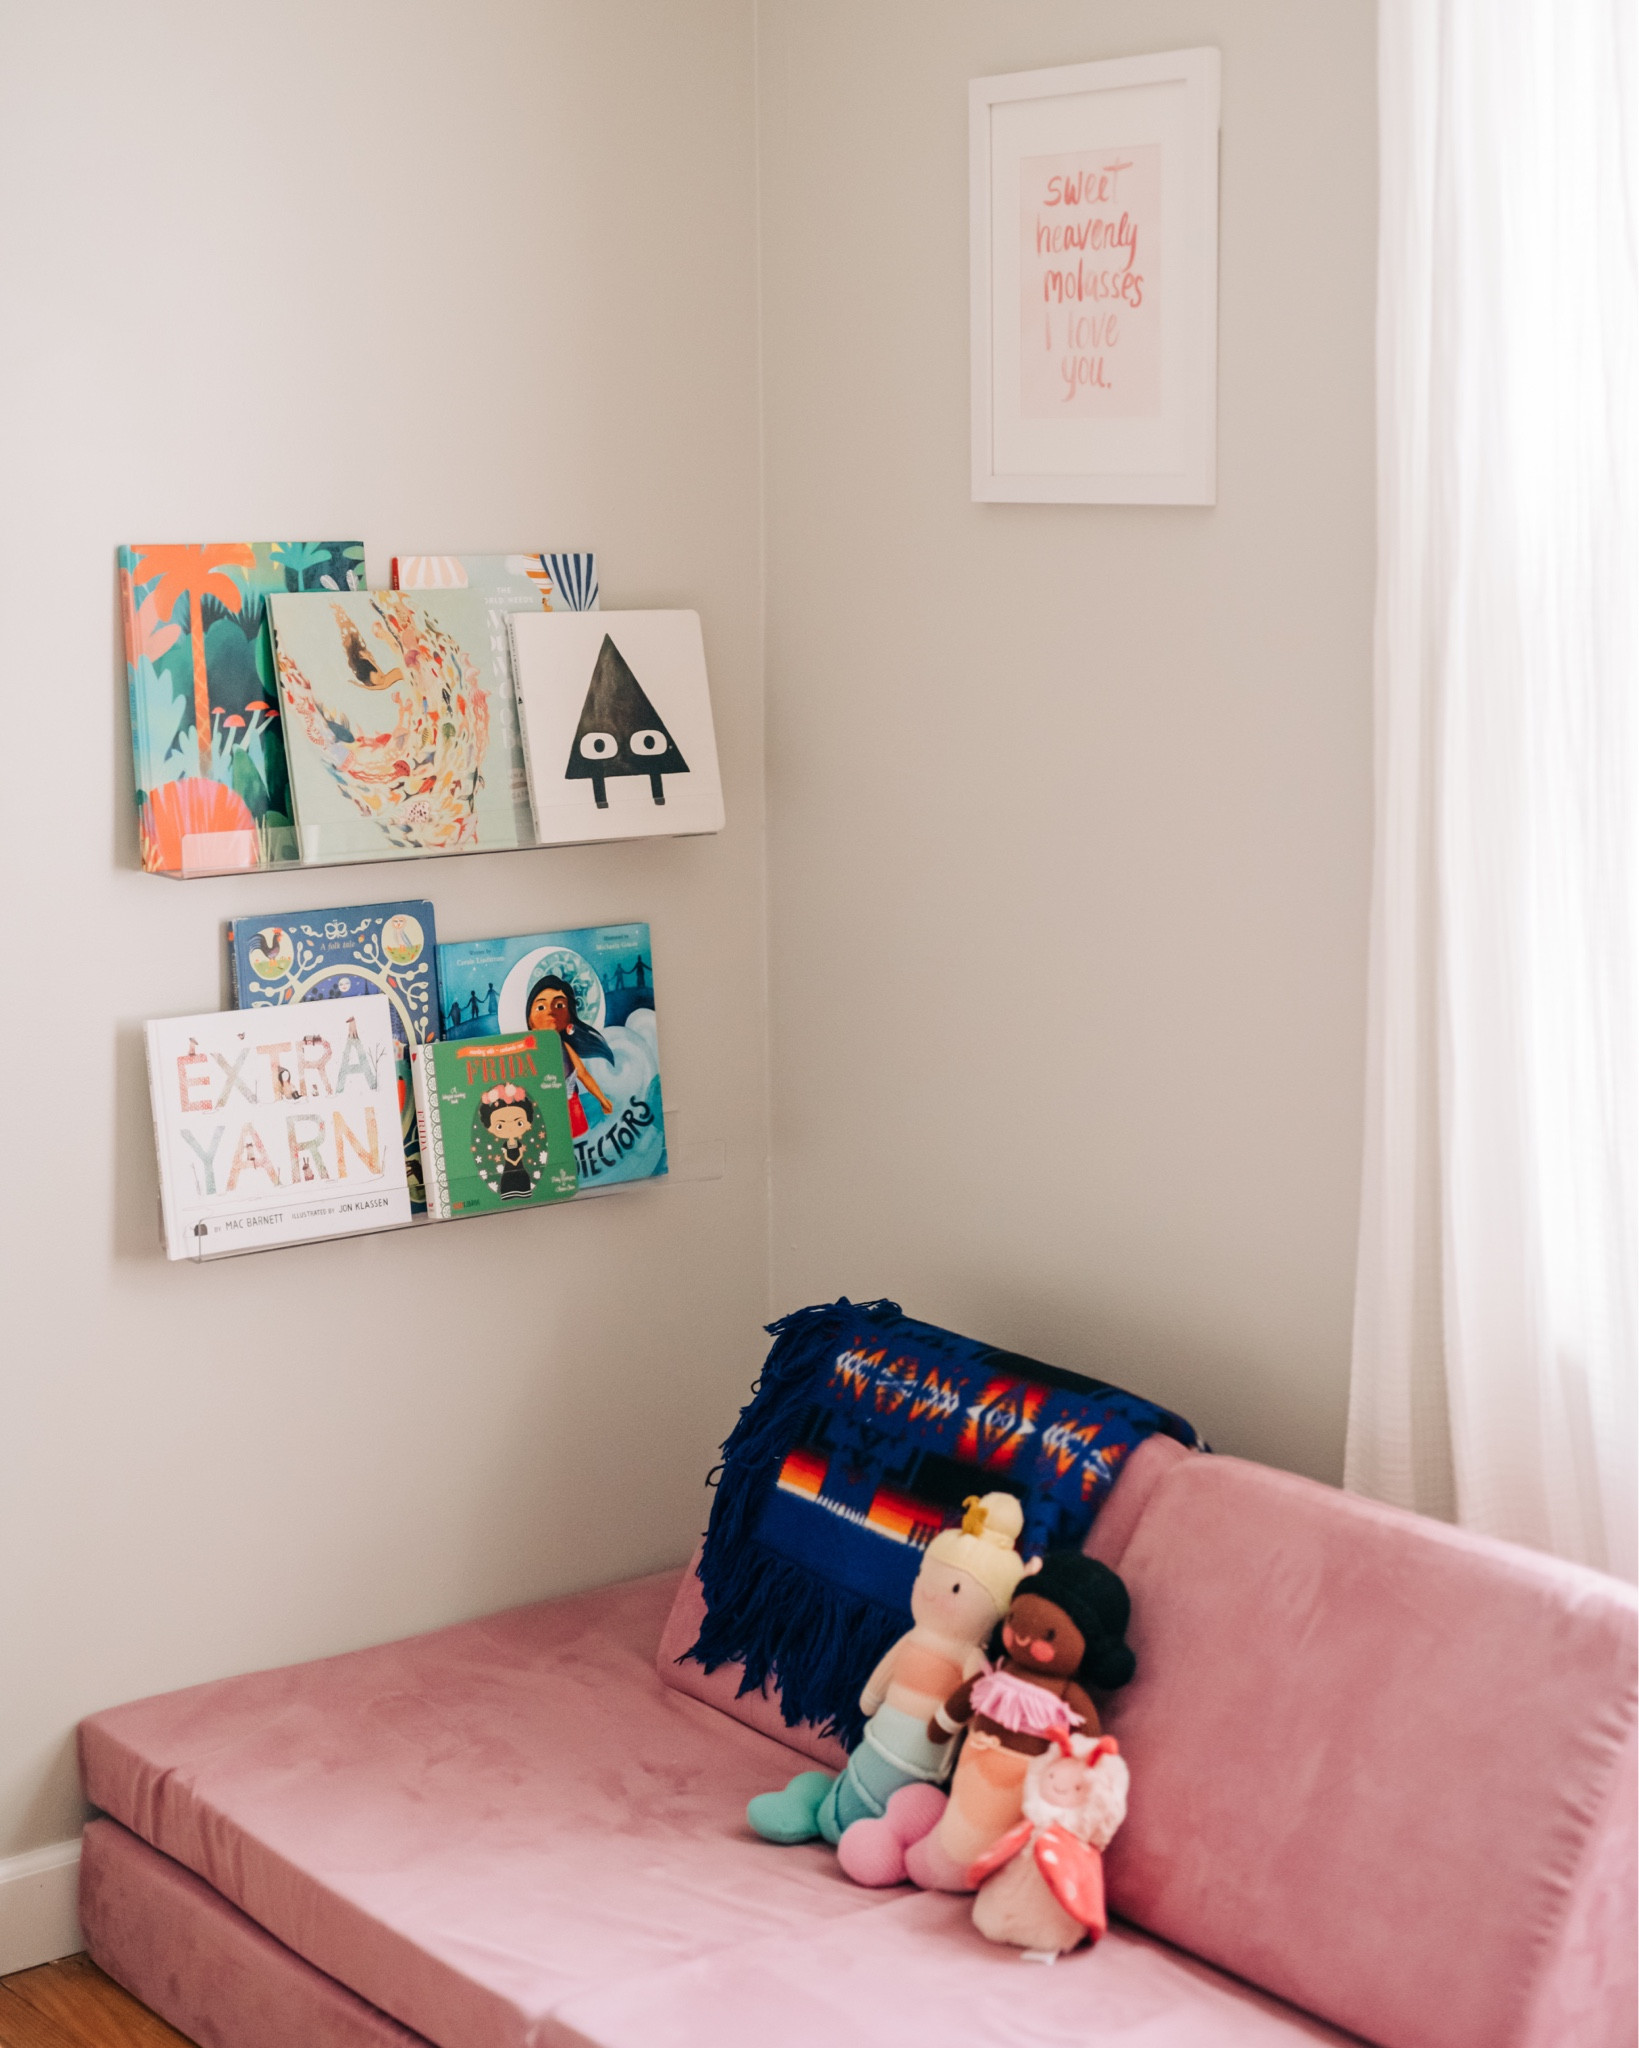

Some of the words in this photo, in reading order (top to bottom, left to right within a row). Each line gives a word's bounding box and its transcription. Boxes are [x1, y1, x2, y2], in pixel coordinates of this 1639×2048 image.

[1037, 211, 1138, 273] heavenly
[1044, 256, 1144, 308] molasses
[1067, 311, 1119, 349] love
[1061, 355, 1112, 402] you.
[320, 943, 326, 951] A
[326, 941, 341, 953] folk
[342, 940, 356, 949] tale
[177, 1037, 378, 1112] EXTRA
[466, 1053, 537, 1085] FRIDA
[180, 1106, 383, 1195] YARN
[417, 1111, 427, 1151] FRIDA
[573, 1095, 655, 1178] TECTORS
[225, 1219, 243, 1231] MAC
[246, 1213, 284, 1228] BARNETT
[291, 1208, 327, 1220] ILLUSTRATED
[338, 1203, 353, 1214] JON
[355, 1198, 389, 1211] KLASSEN
